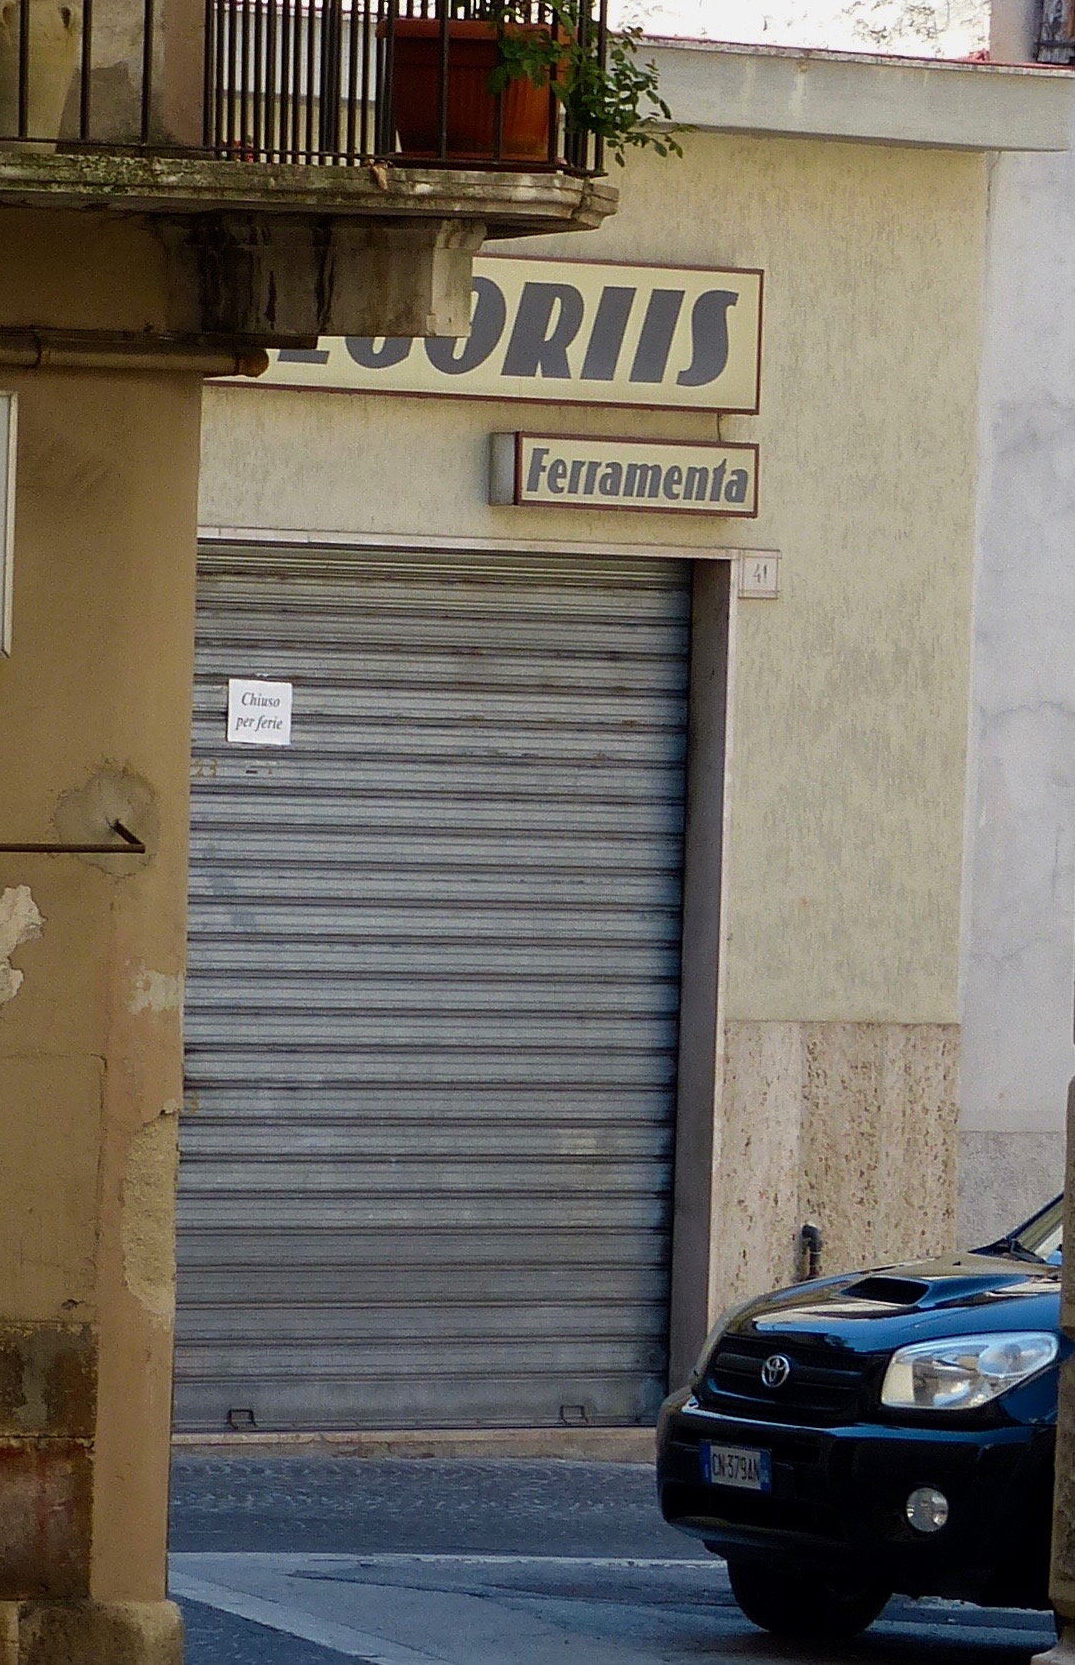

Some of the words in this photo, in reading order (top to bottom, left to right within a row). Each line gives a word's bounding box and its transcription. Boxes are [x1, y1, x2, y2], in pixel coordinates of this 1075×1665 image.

[277, 275, 739, 387] ORIIS
[526, 447, 749, 503] Ferramenta
[241, 691, 281, 708] Chiuso
[235, 716, 255, 731] per
[254, 715, 284, 732] ferie
